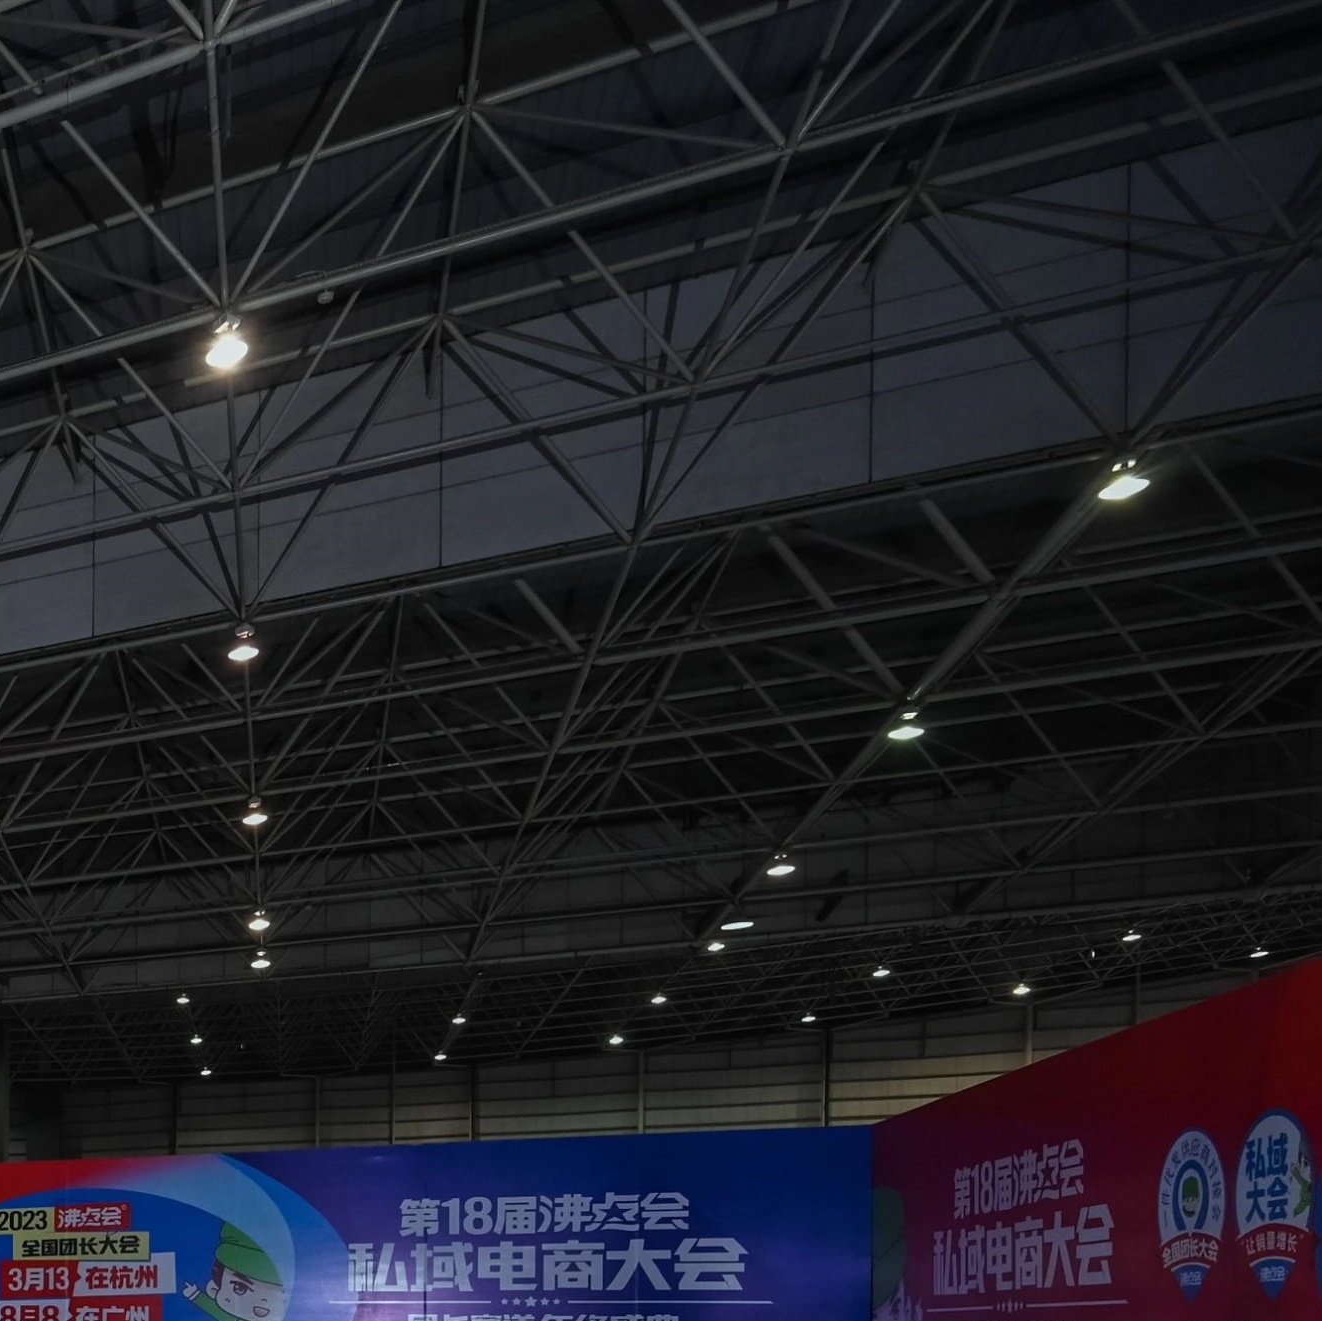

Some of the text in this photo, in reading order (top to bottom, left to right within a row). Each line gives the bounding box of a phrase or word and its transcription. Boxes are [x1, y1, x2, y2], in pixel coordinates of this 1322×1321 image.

[953, 1138, 1085, 1220] 第18届沸点会
[1245, 1132, 1289, 1181] 私域
[399, 1191, 691, 1238] 第18届沸点会
[1245, 1177, 1289, 1225] 大会
[21, 1235, 140, 1258] 全国团长大会
[347, 1237, 750, 1293] 私域电商大会
[932, 1203, 1115, 1296] 私域电商大会
[1161, 1236, 1219, 1264] 全国团长大会
[7, 1264, 159, 1292] 3月13 在杭州
